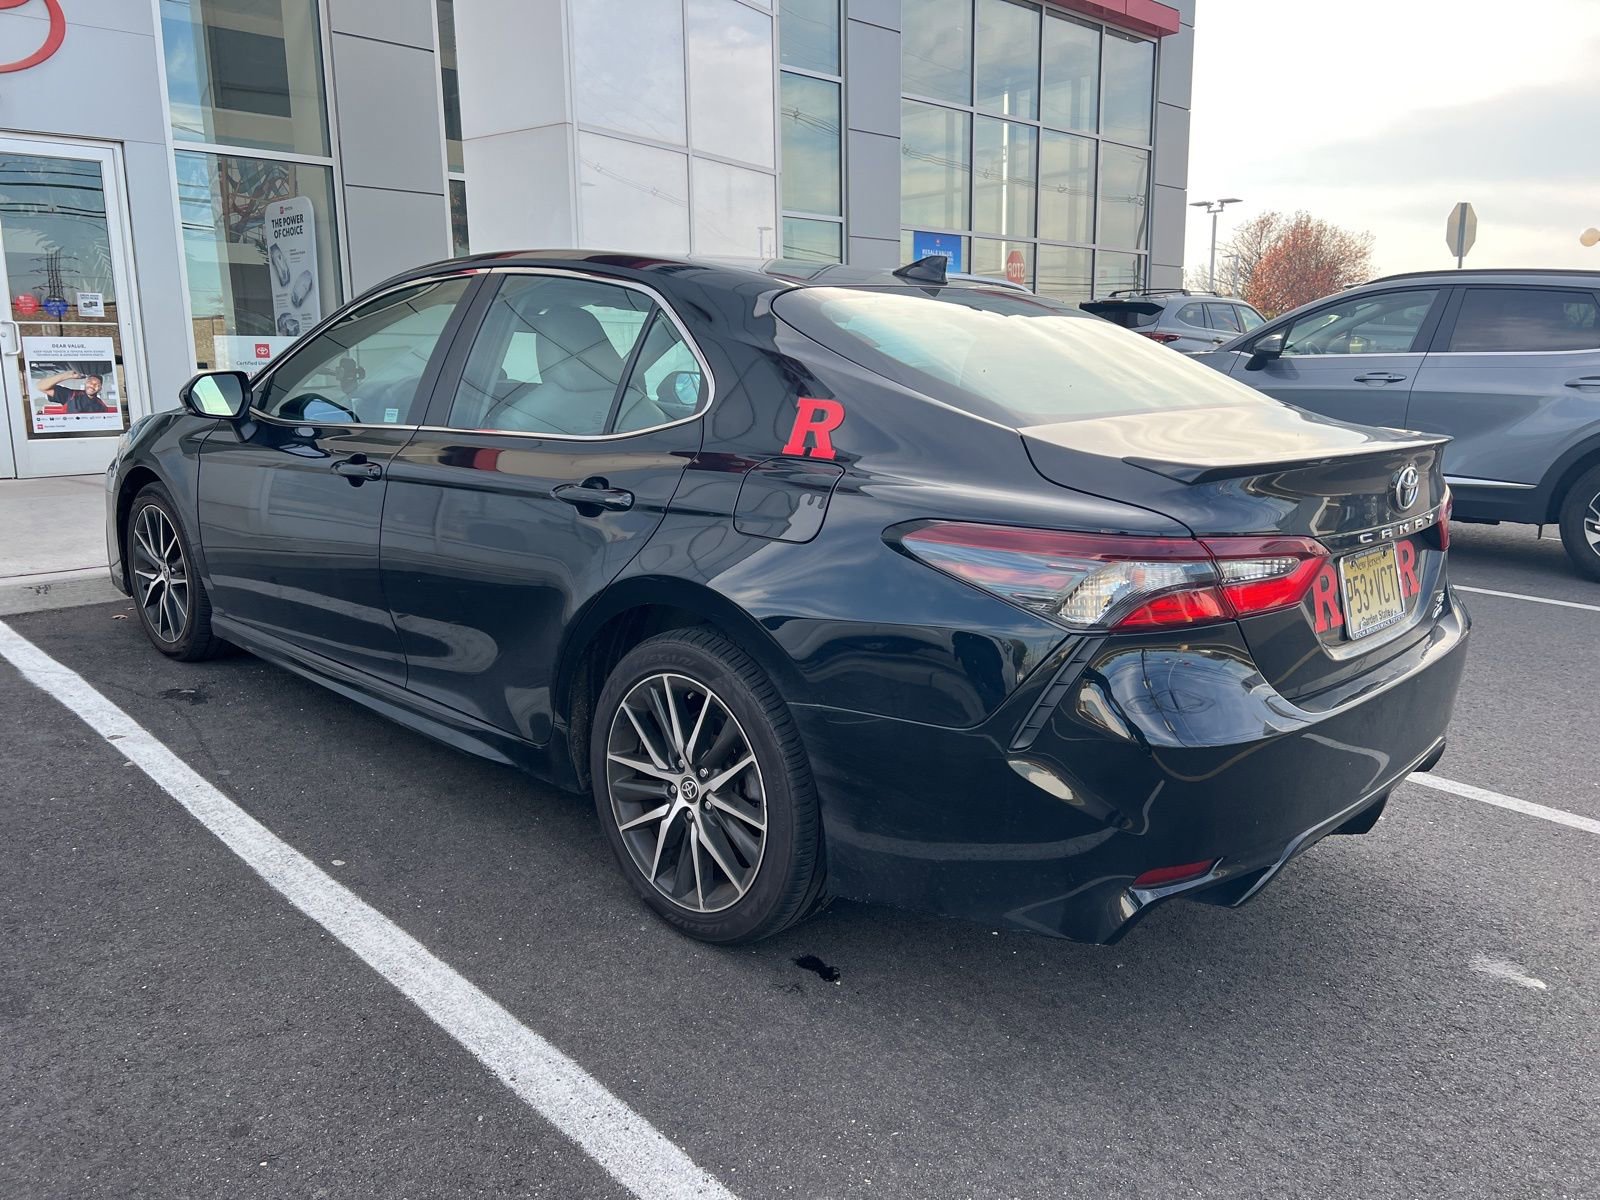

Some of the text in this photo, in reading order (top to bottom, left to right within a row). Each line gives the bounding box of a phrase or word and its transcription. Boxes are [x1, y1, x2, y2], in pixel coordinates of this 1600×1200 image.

[271, 214, 304, 229] THE POWER
[273, 225, 303, 239] OF CHOICE
[782, 397, 846, 460] R
[1359, 513, 1434, 544] CAMRY
[1353, 556, 1383, 571] New Jersey
[1396, 540, 1421, 598] R
[1311, 563, 1344, 633] R
[1361, 613, 1378, 627] Garden
